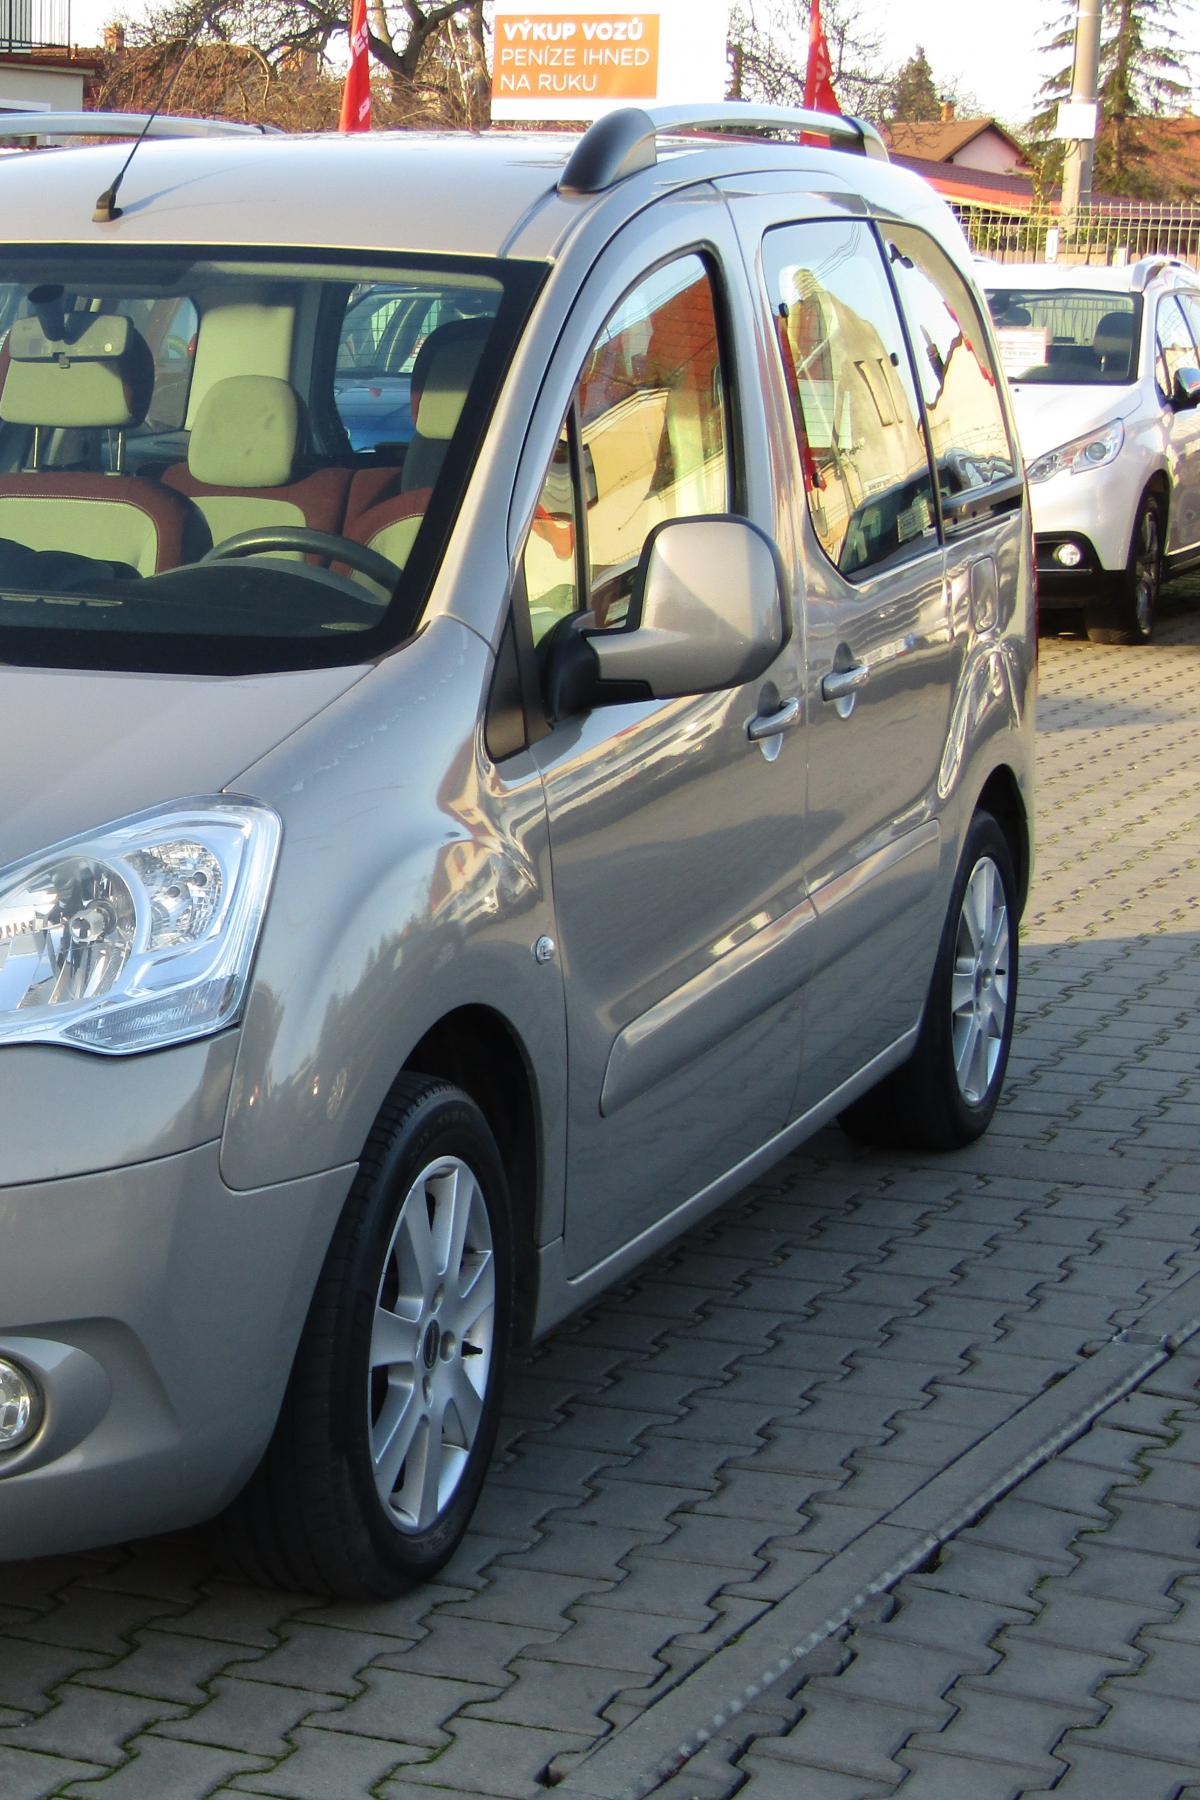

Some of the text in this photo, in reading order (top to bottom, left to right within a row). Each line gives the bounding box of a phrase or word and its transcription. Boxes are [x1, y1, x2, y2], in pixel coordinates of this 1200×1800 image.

[503, 17, 644, 41] VÝKUP VOZŮ
[500, 45, 650, 67] PENÍZE IHNED
[500, 74, 597, 92] NA RUKU
